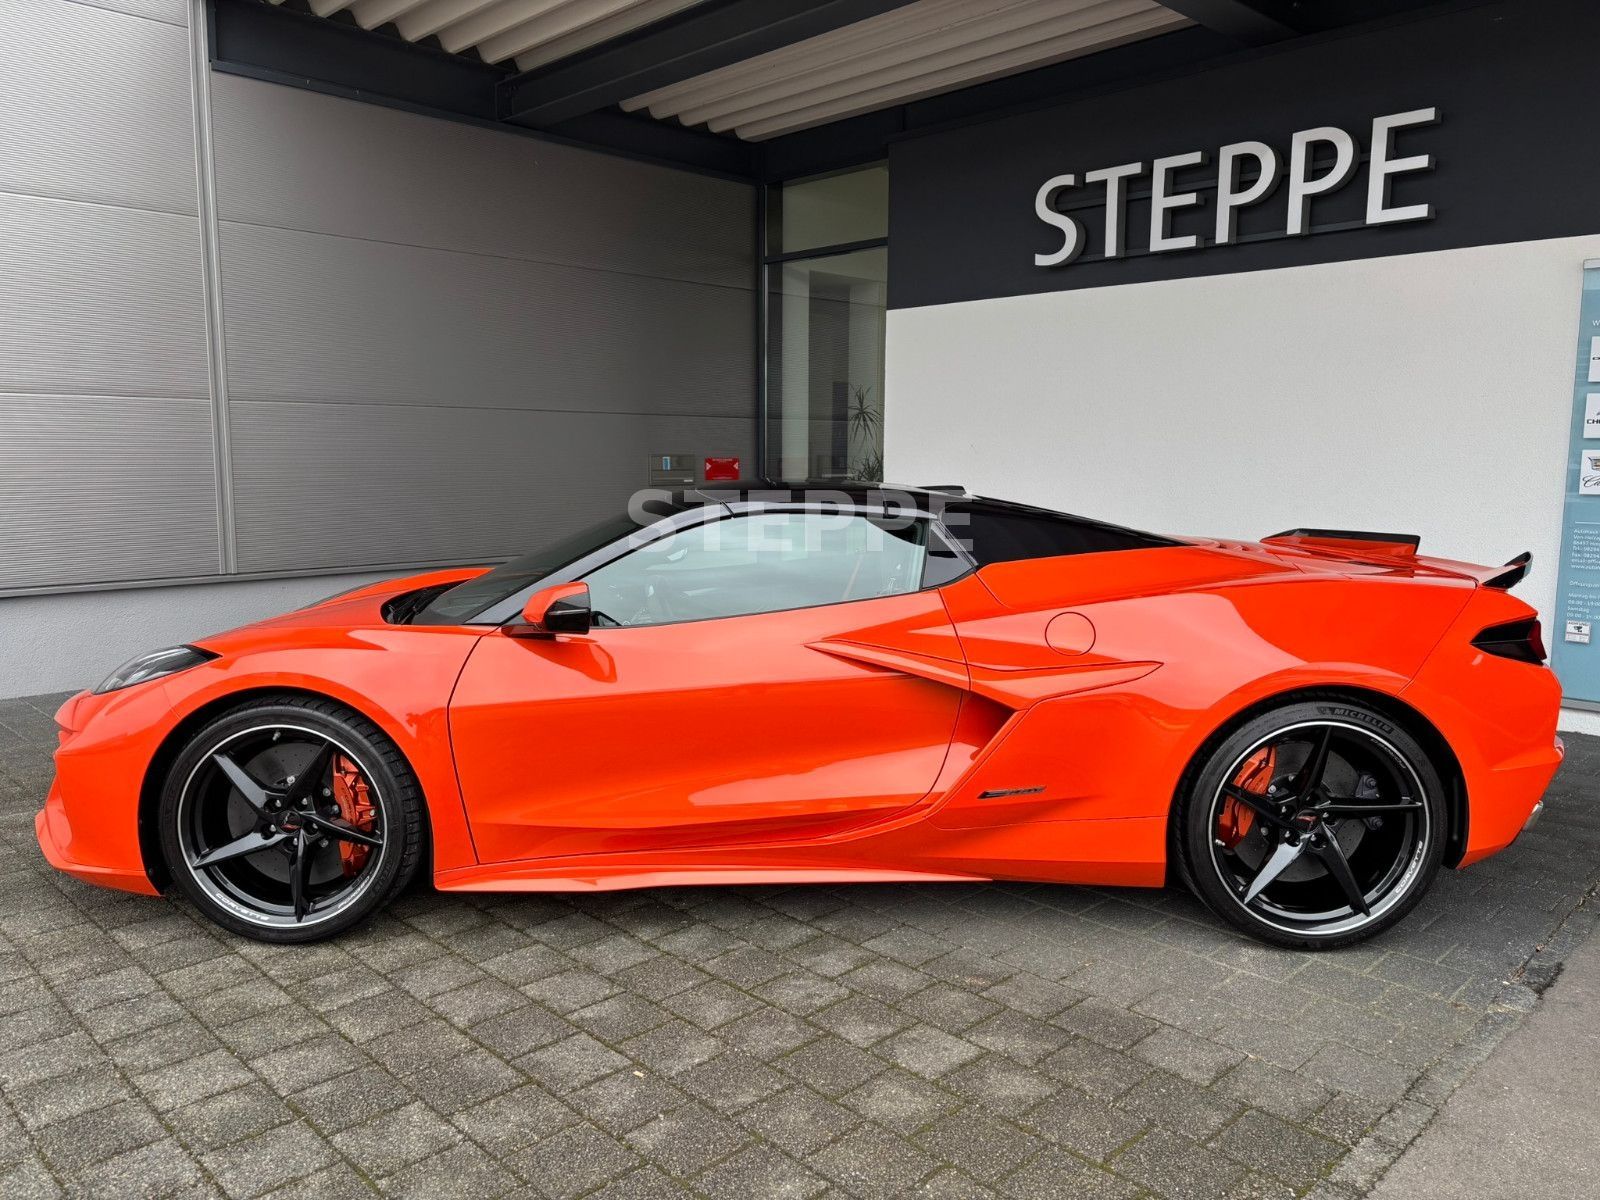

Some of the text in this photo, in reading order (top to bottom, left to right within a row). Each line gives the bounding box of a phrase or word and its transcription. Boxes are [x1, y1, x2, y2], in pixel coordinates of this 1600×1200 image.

[1034, 107, 1438, 267] STEPPE
[1334, 708, 1394, 733] MICHELIN
[1395, 840, 1423, 893] CORVETTE
[215, 893, 270, 921] CORVETTE
